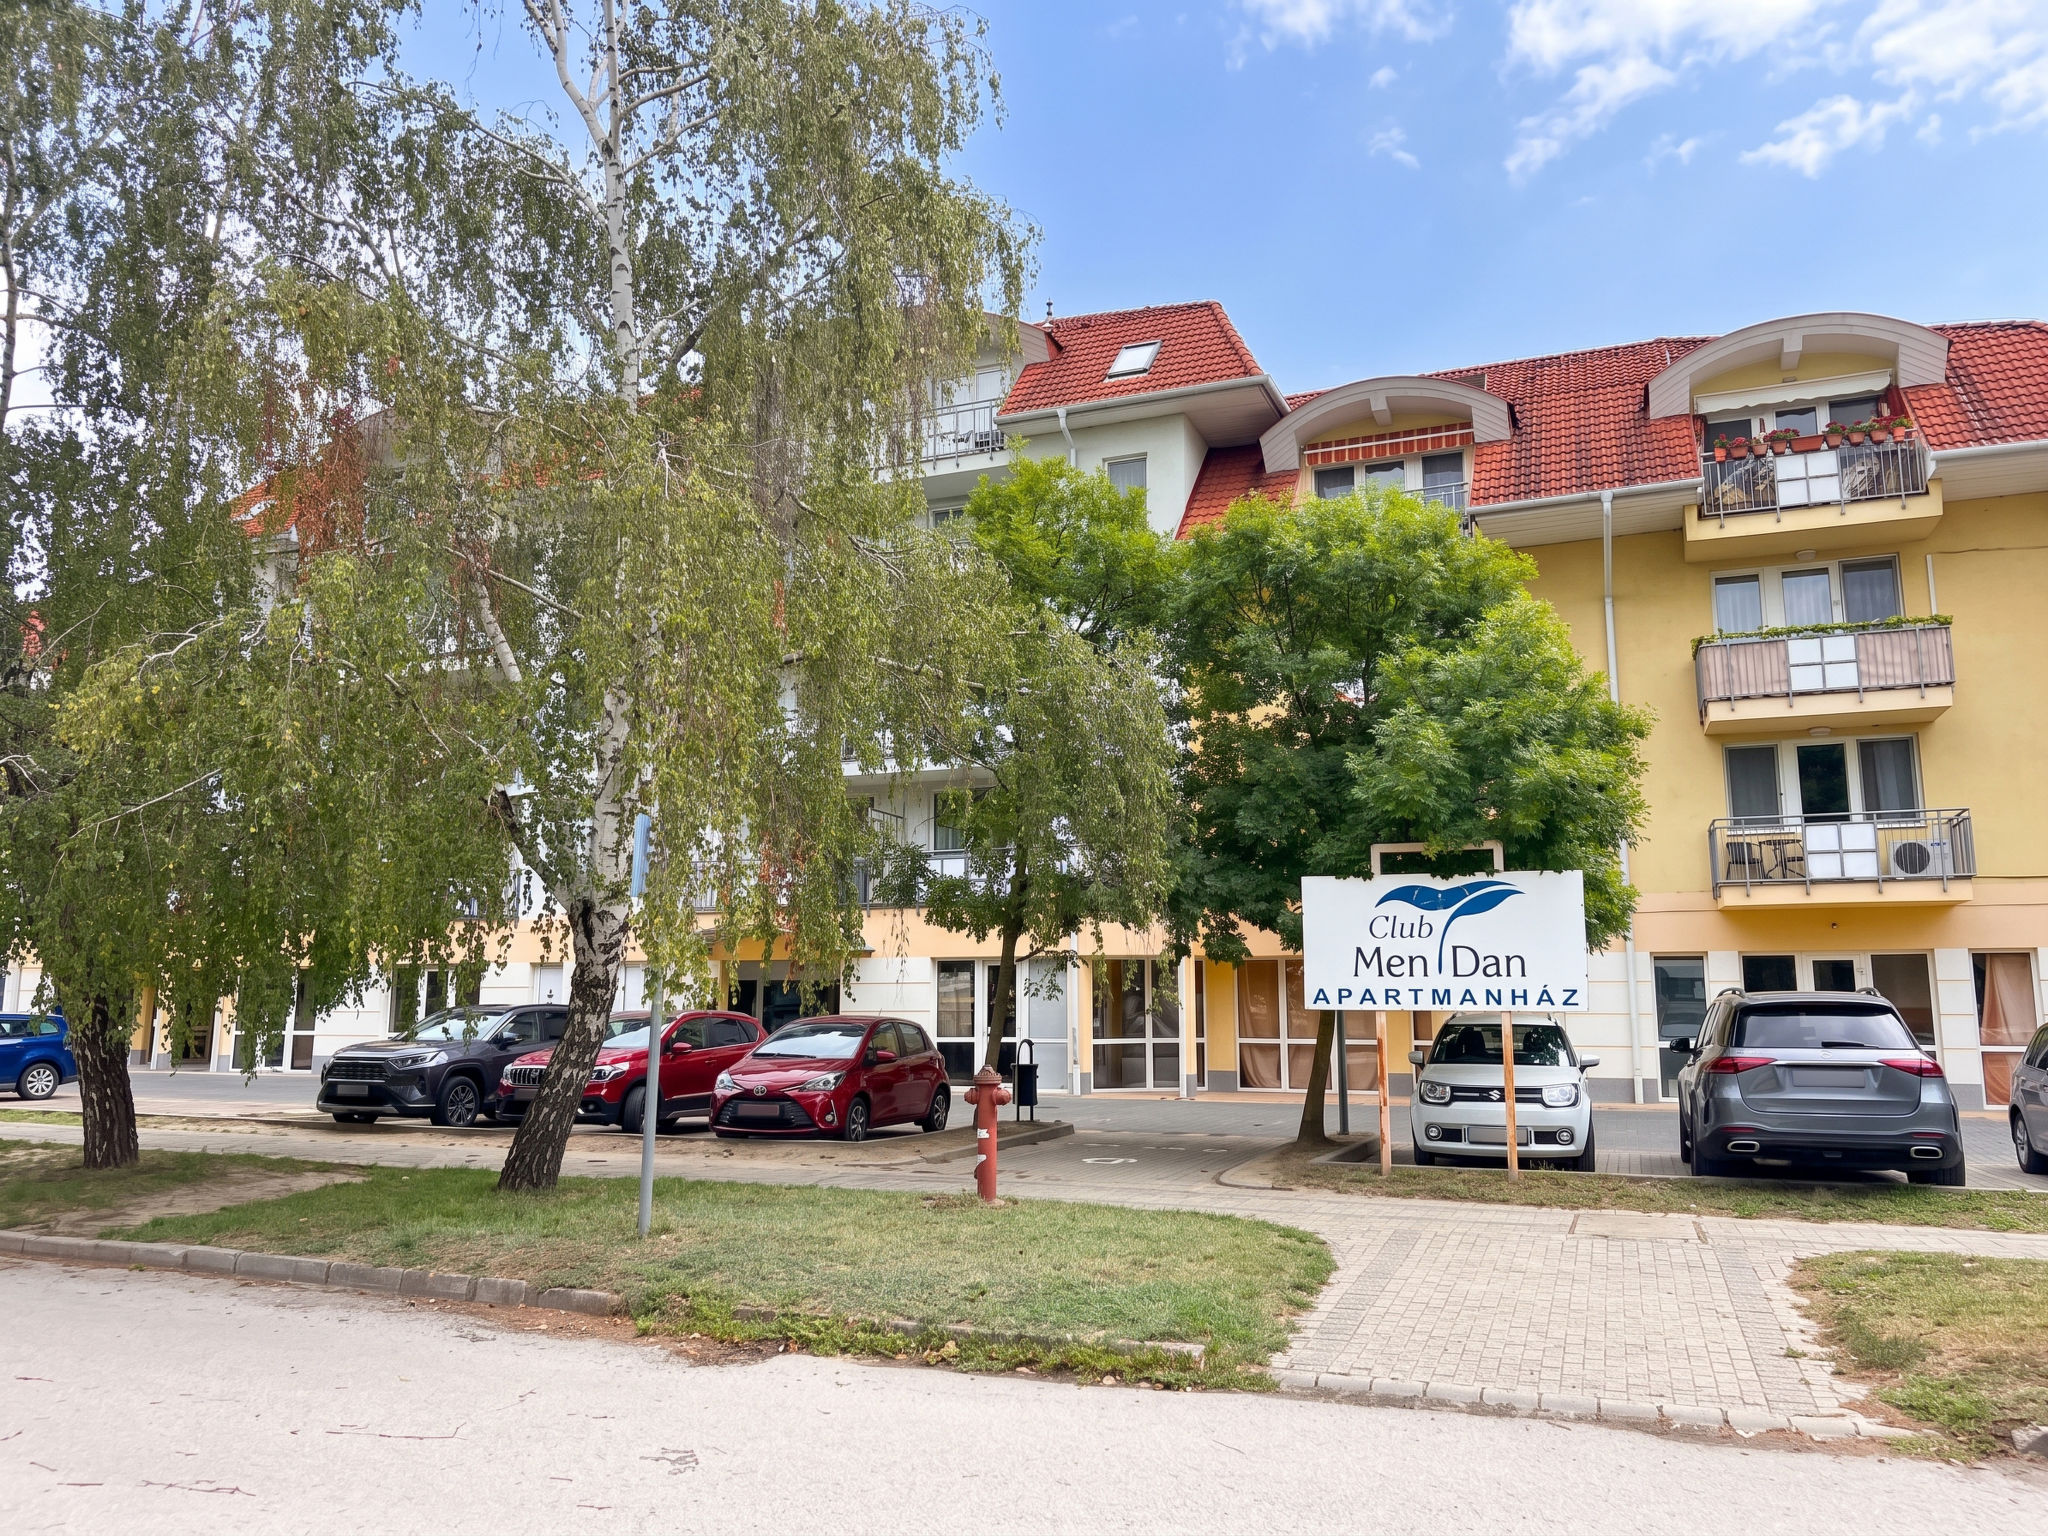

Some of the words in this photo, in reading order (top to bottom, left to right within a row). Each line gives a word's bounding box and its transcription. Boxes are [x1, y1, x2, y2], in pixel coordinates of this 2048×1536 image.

[1369, 914, 1434, 939] Club
[1353, 946, 1429, 978] Men
[1451, 945, 1527, 978] Dan
[1312, 984, 1579, 1007] APARTMANHÁZ
